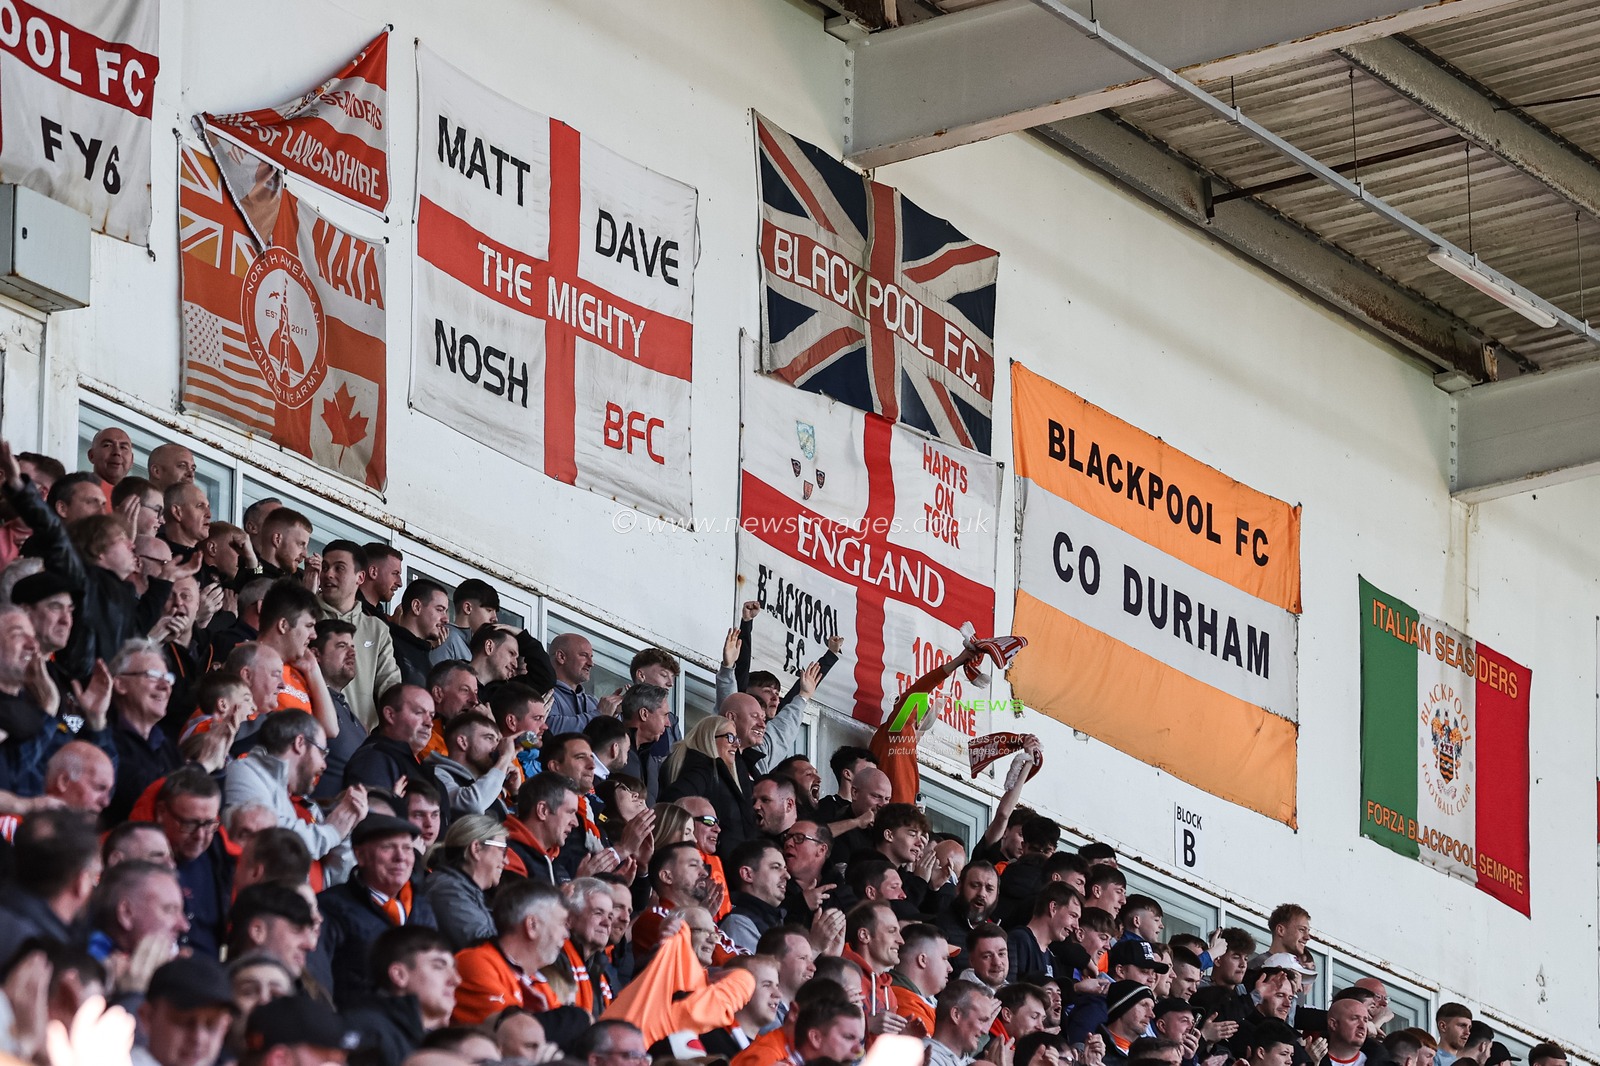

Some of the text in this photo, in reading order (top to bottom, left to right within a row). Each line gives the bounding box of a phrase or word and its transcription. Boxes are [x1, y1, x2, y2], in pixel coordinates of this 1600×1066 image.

[96, 48, 146, 108] FC
[40, 115, 122, 195] FY6
[281, 126, 382, 200] LANCASHIRE
[438, 114, 531, 207] MATT
[247, 254, 278, 294] NORTH
[312, 217, 384, 311] NATA
[594, 207, 680, 287] DAVE
[291, 325, 308, 337] 2011
[477, 241, 646, 358] THE MIGHTY
[774, 228, 981, 392] BLACKPOOL F.C.
[295, 365, 321, 399] ARMY
[434, 318, 529, 409] NOSH
[603, 401, 665, 465] BFC
[923, 442, 968, 494] HARTS
[923, 502, 961, 549] TOUR
[934, 482, 954, 516] ON
[1048, 418, 1270, 567] BLACKPOOL FC
[797, 514, 946, 609] ENGLAND
[1052, 531, 1270, 680] CO DURHAM
[1372, 597, 1519, 700] ITALIAN SEASIDERS
[1177, 806, 1202, 830] BLOCK
[1184, 829, 1196, 867] B
[1366, 800, 1523, 896] FORZA BLACKPOOL SEMPRE
